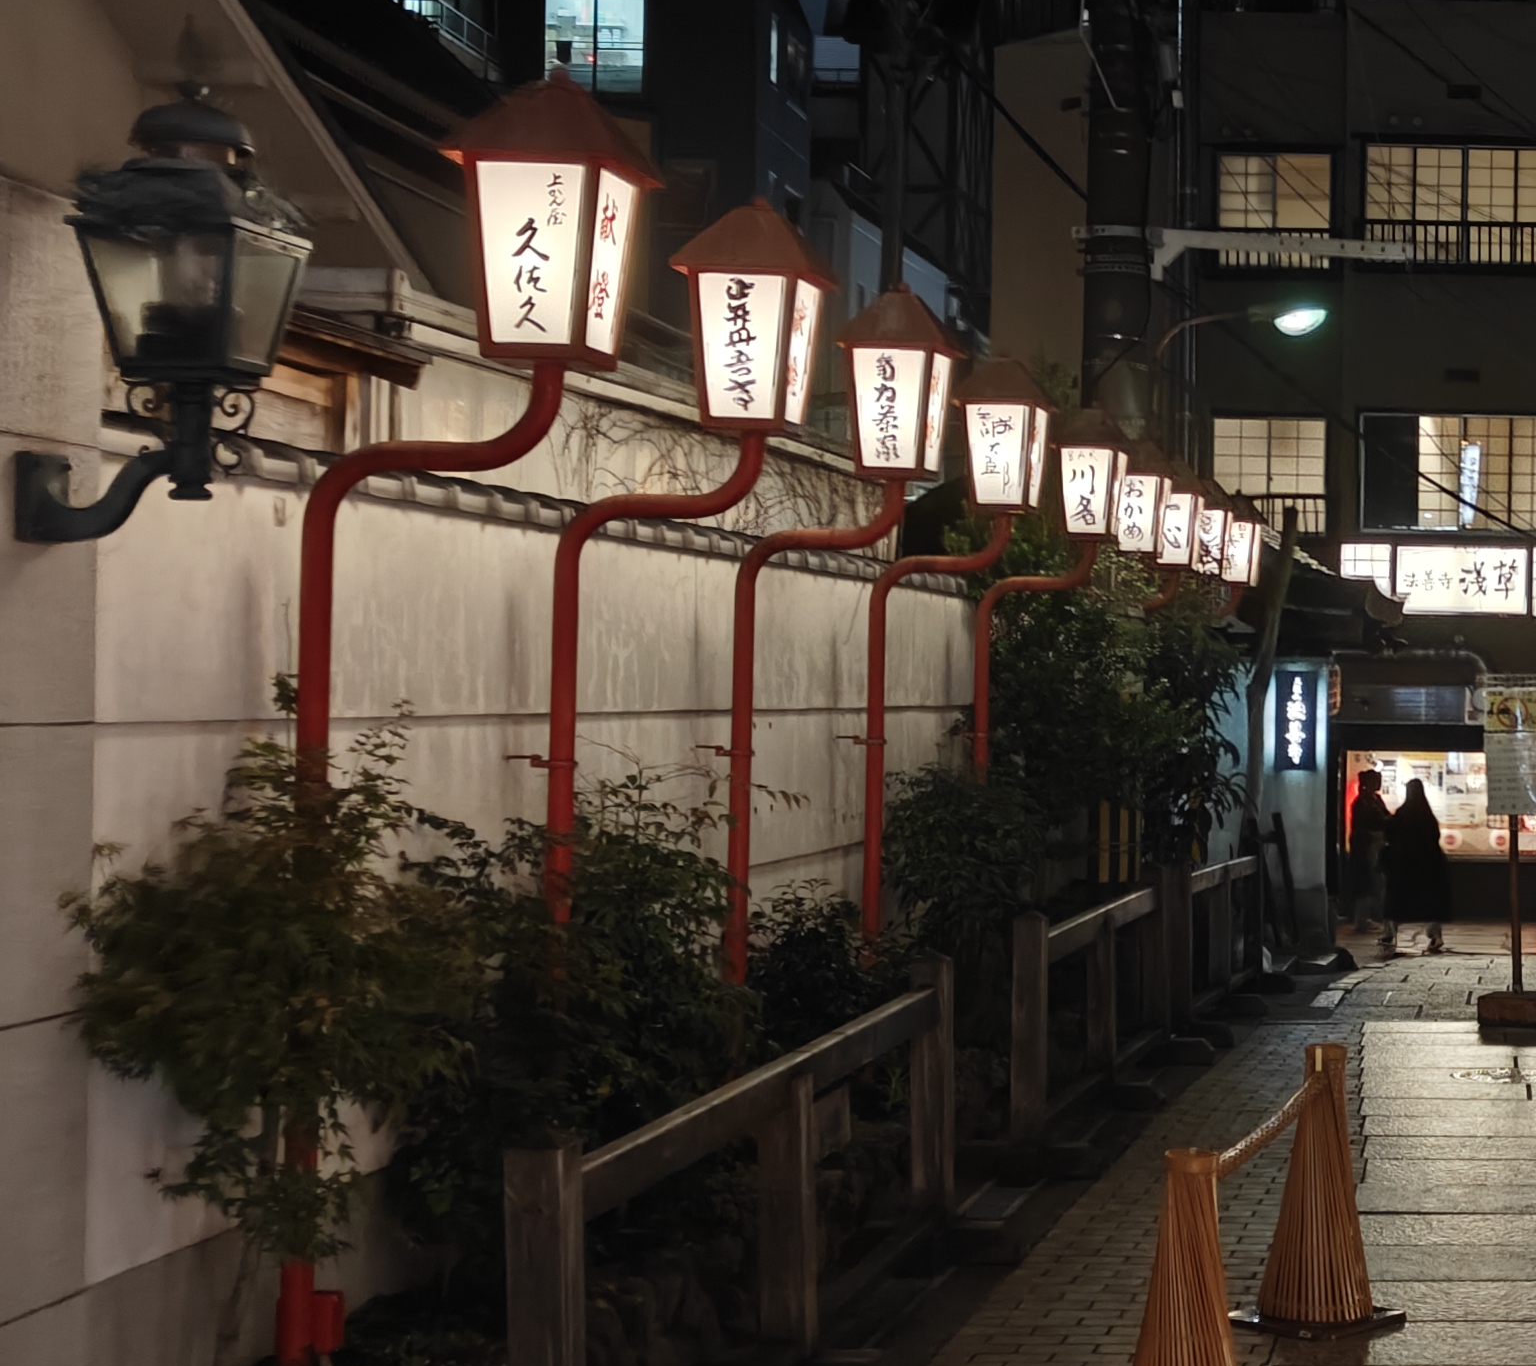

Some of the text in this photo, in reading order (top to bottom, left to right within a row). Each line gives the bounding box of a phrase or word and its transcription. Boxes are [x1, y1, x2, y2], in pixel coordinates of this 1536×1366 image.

[511, 217, 550, 333] 久佐久
[1068, 450, 1098, 462] BAR
[1069, 464, 1097, 526] 川名
[1123, 480, 1144, 541] おかめ
[1459, 561, 1519, 600] 浅草
